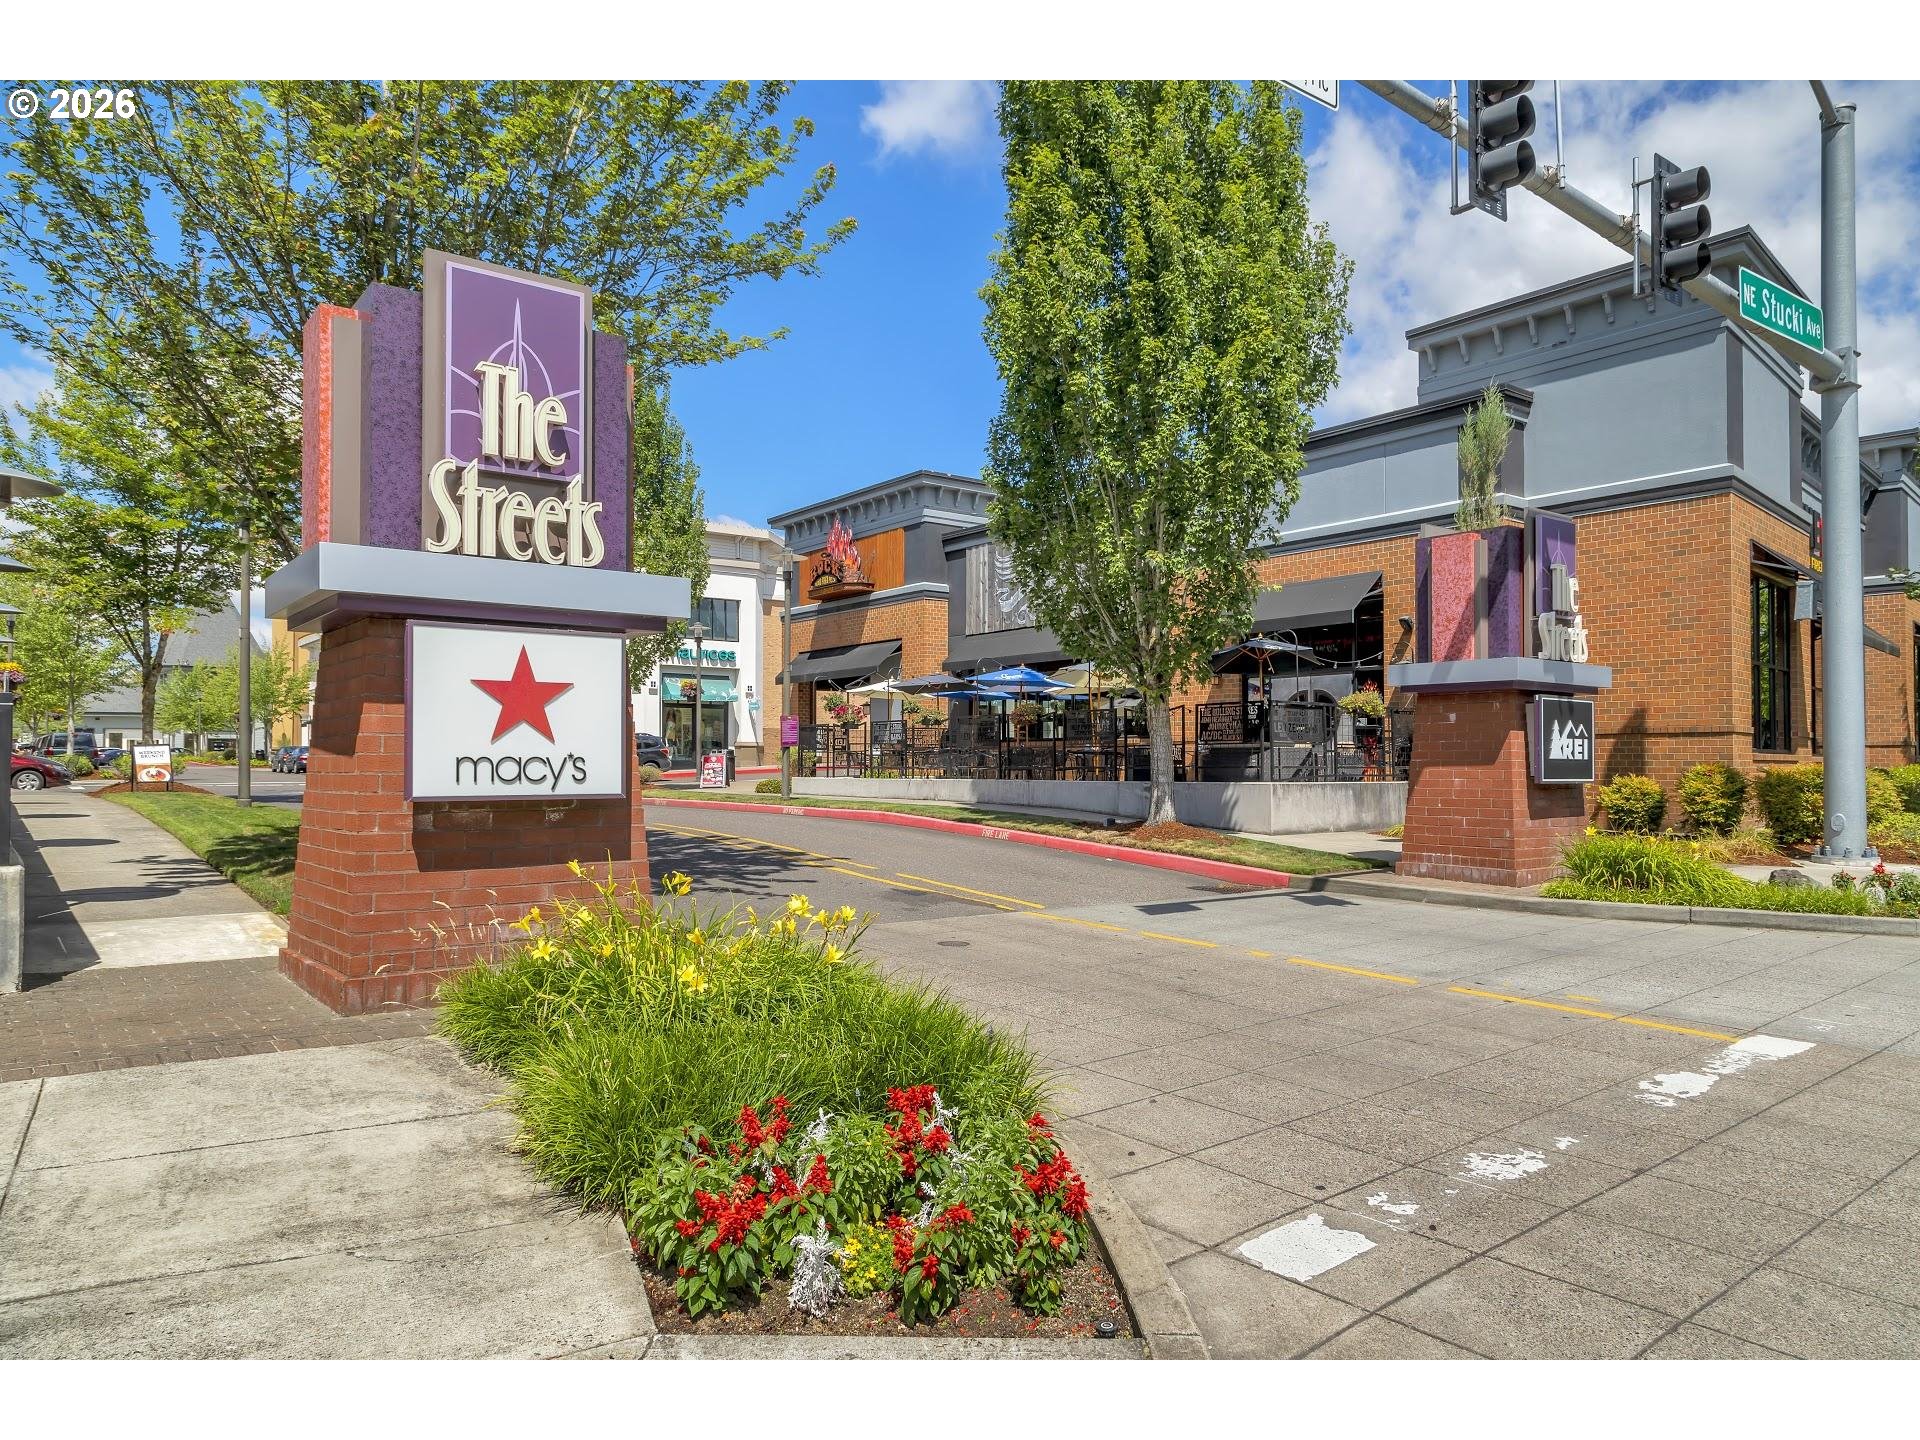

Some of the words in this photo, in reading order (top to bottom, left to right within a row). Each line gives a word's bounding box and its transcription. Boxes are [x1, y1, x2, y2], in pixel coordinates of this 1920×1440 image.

[1743, 282, 1757, 308] NE
[1761, 288, 1804, 336] Stucki
[1806, 315, 1821, 340] Ave
[474, 361, 567, 467] The
[425, 457, 604, 567] Streets
[1550, 563, 1580, 613] The
[1538, 611, 1589, 663] Streets
[455, 752, 587, 792] macy's
[1562, 738, 1588, 760] REI
[981, 829, 994, 838] FIRE
[995, 831, 1009, 840] LANE
